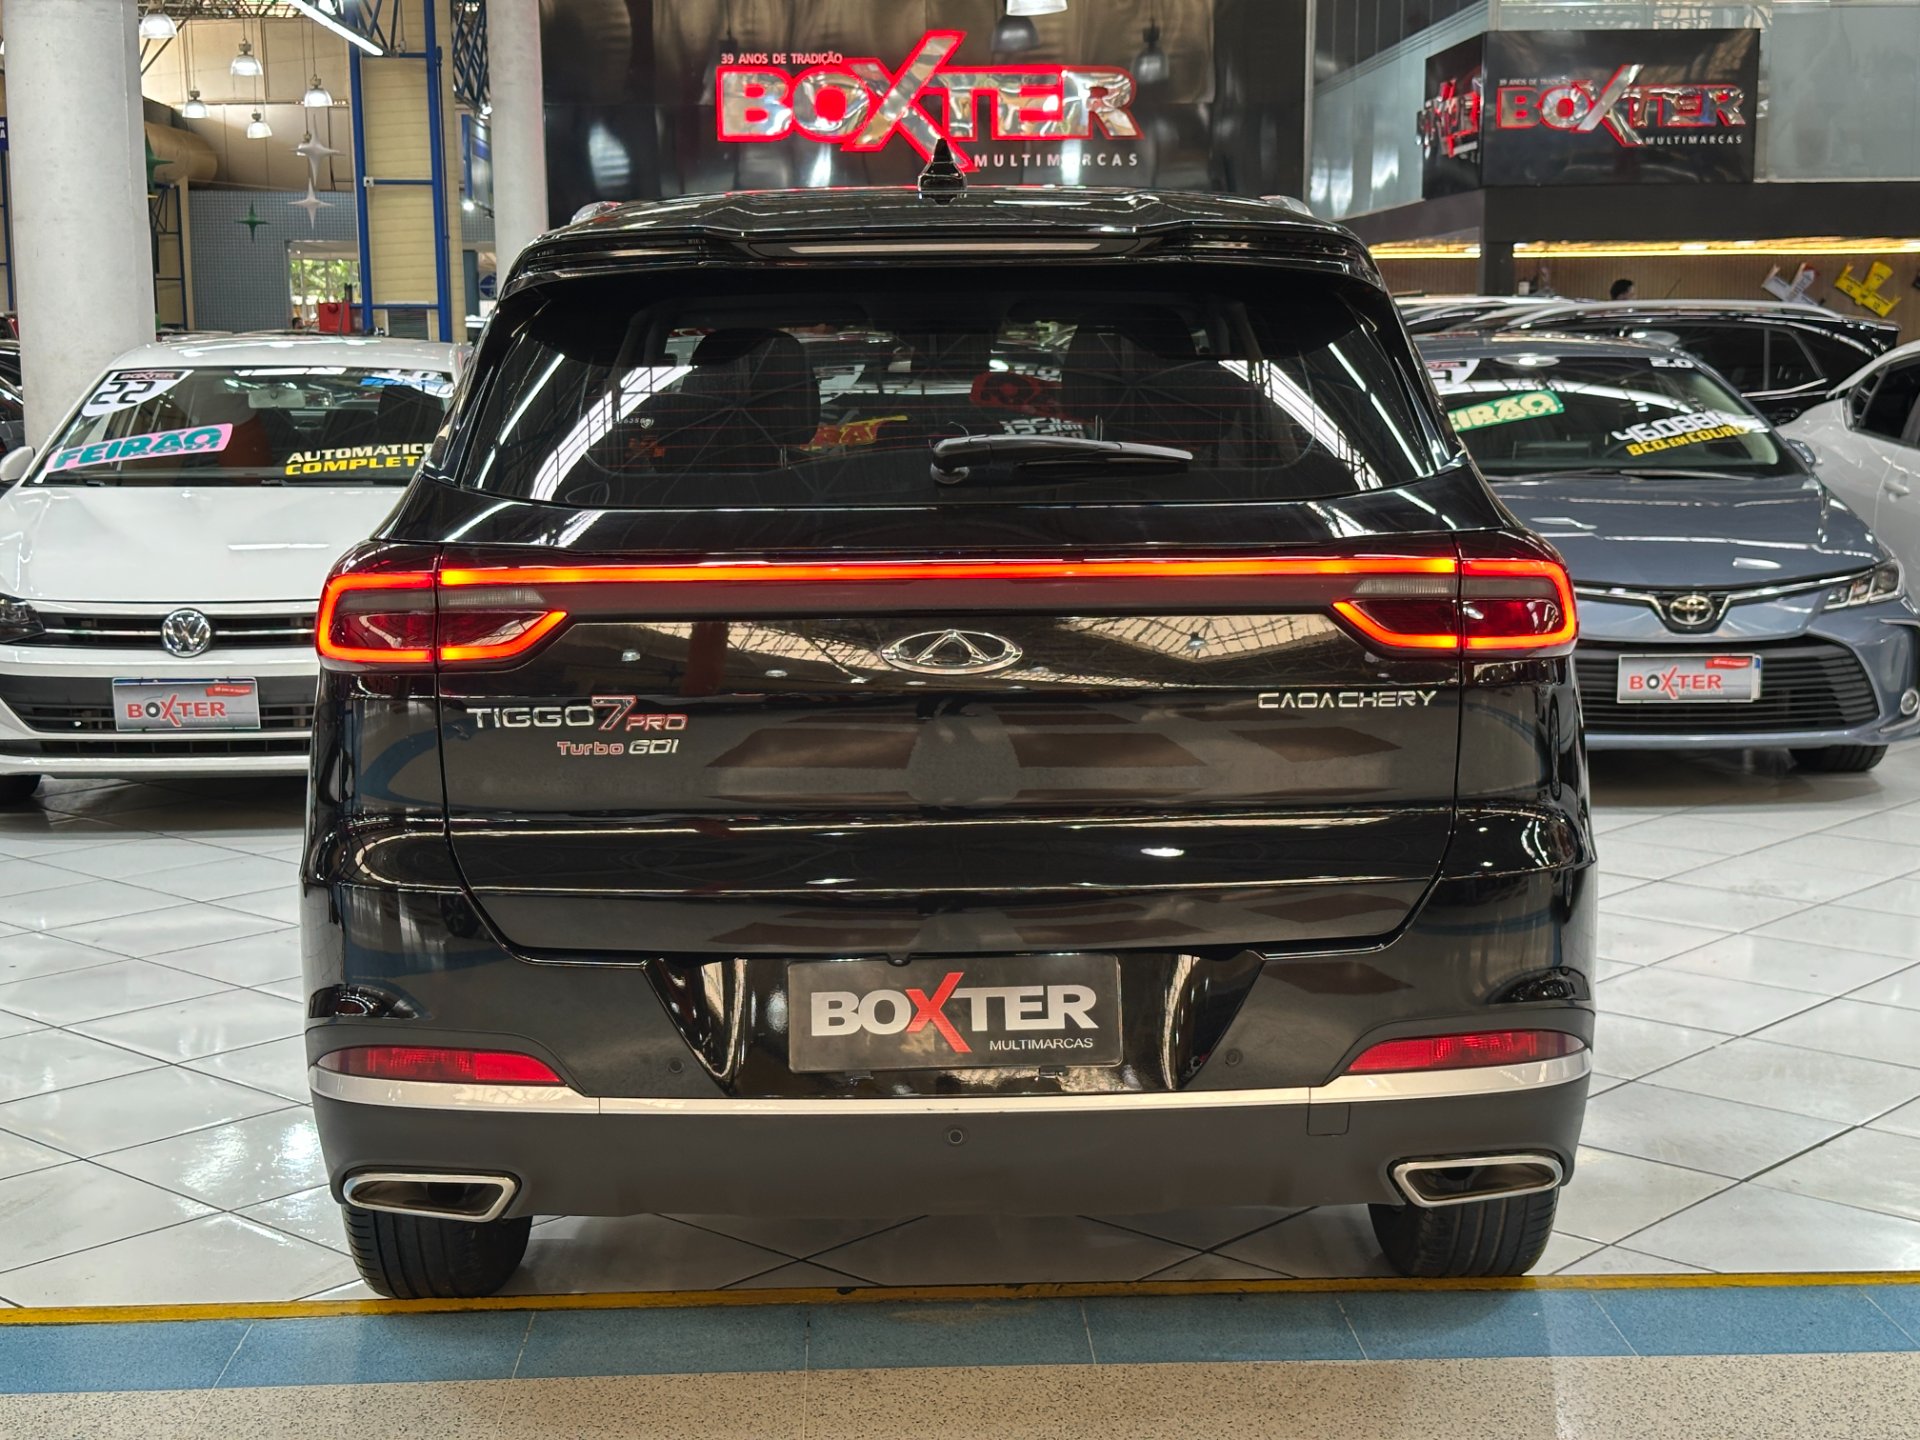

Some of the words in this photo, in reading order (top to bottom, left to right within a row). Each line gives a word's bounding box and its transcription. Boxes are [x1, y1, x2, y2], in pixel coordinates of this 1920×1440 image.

[720, 53, 735, 65] 39
[738, 53, 769, 65] ANOS
[772, 53, 787, 65] DE
[790, 50, 843, 65] TRADIÇÃO
[715, 29, 1145, 172] BOXTER
[1496, 63, 1746, 148] BOXTER
[1645, 135, 1744, 146] MULTIMARCAS
[974, 153, 1139, 167] MULTIMRCAS
[89, 381, 156, 405] 22
[1447, 393, 1564, 431] EIRÃO
[1629, 666, 1723, 699] BOXTER
[126, 693, 228, 727] BOXTER
[466, 705, 595, 729] TIGGO
[591, 694, 638, 731] 7
[625, 713, 689, 732] PRO
[556, 741, 625, 756] Turbo
[628, 738, 680, 755] GDI
[810, 971, 1099, 1053] BOXTER
[989, 1037, 1094, 1051] MULTIMARCAS
